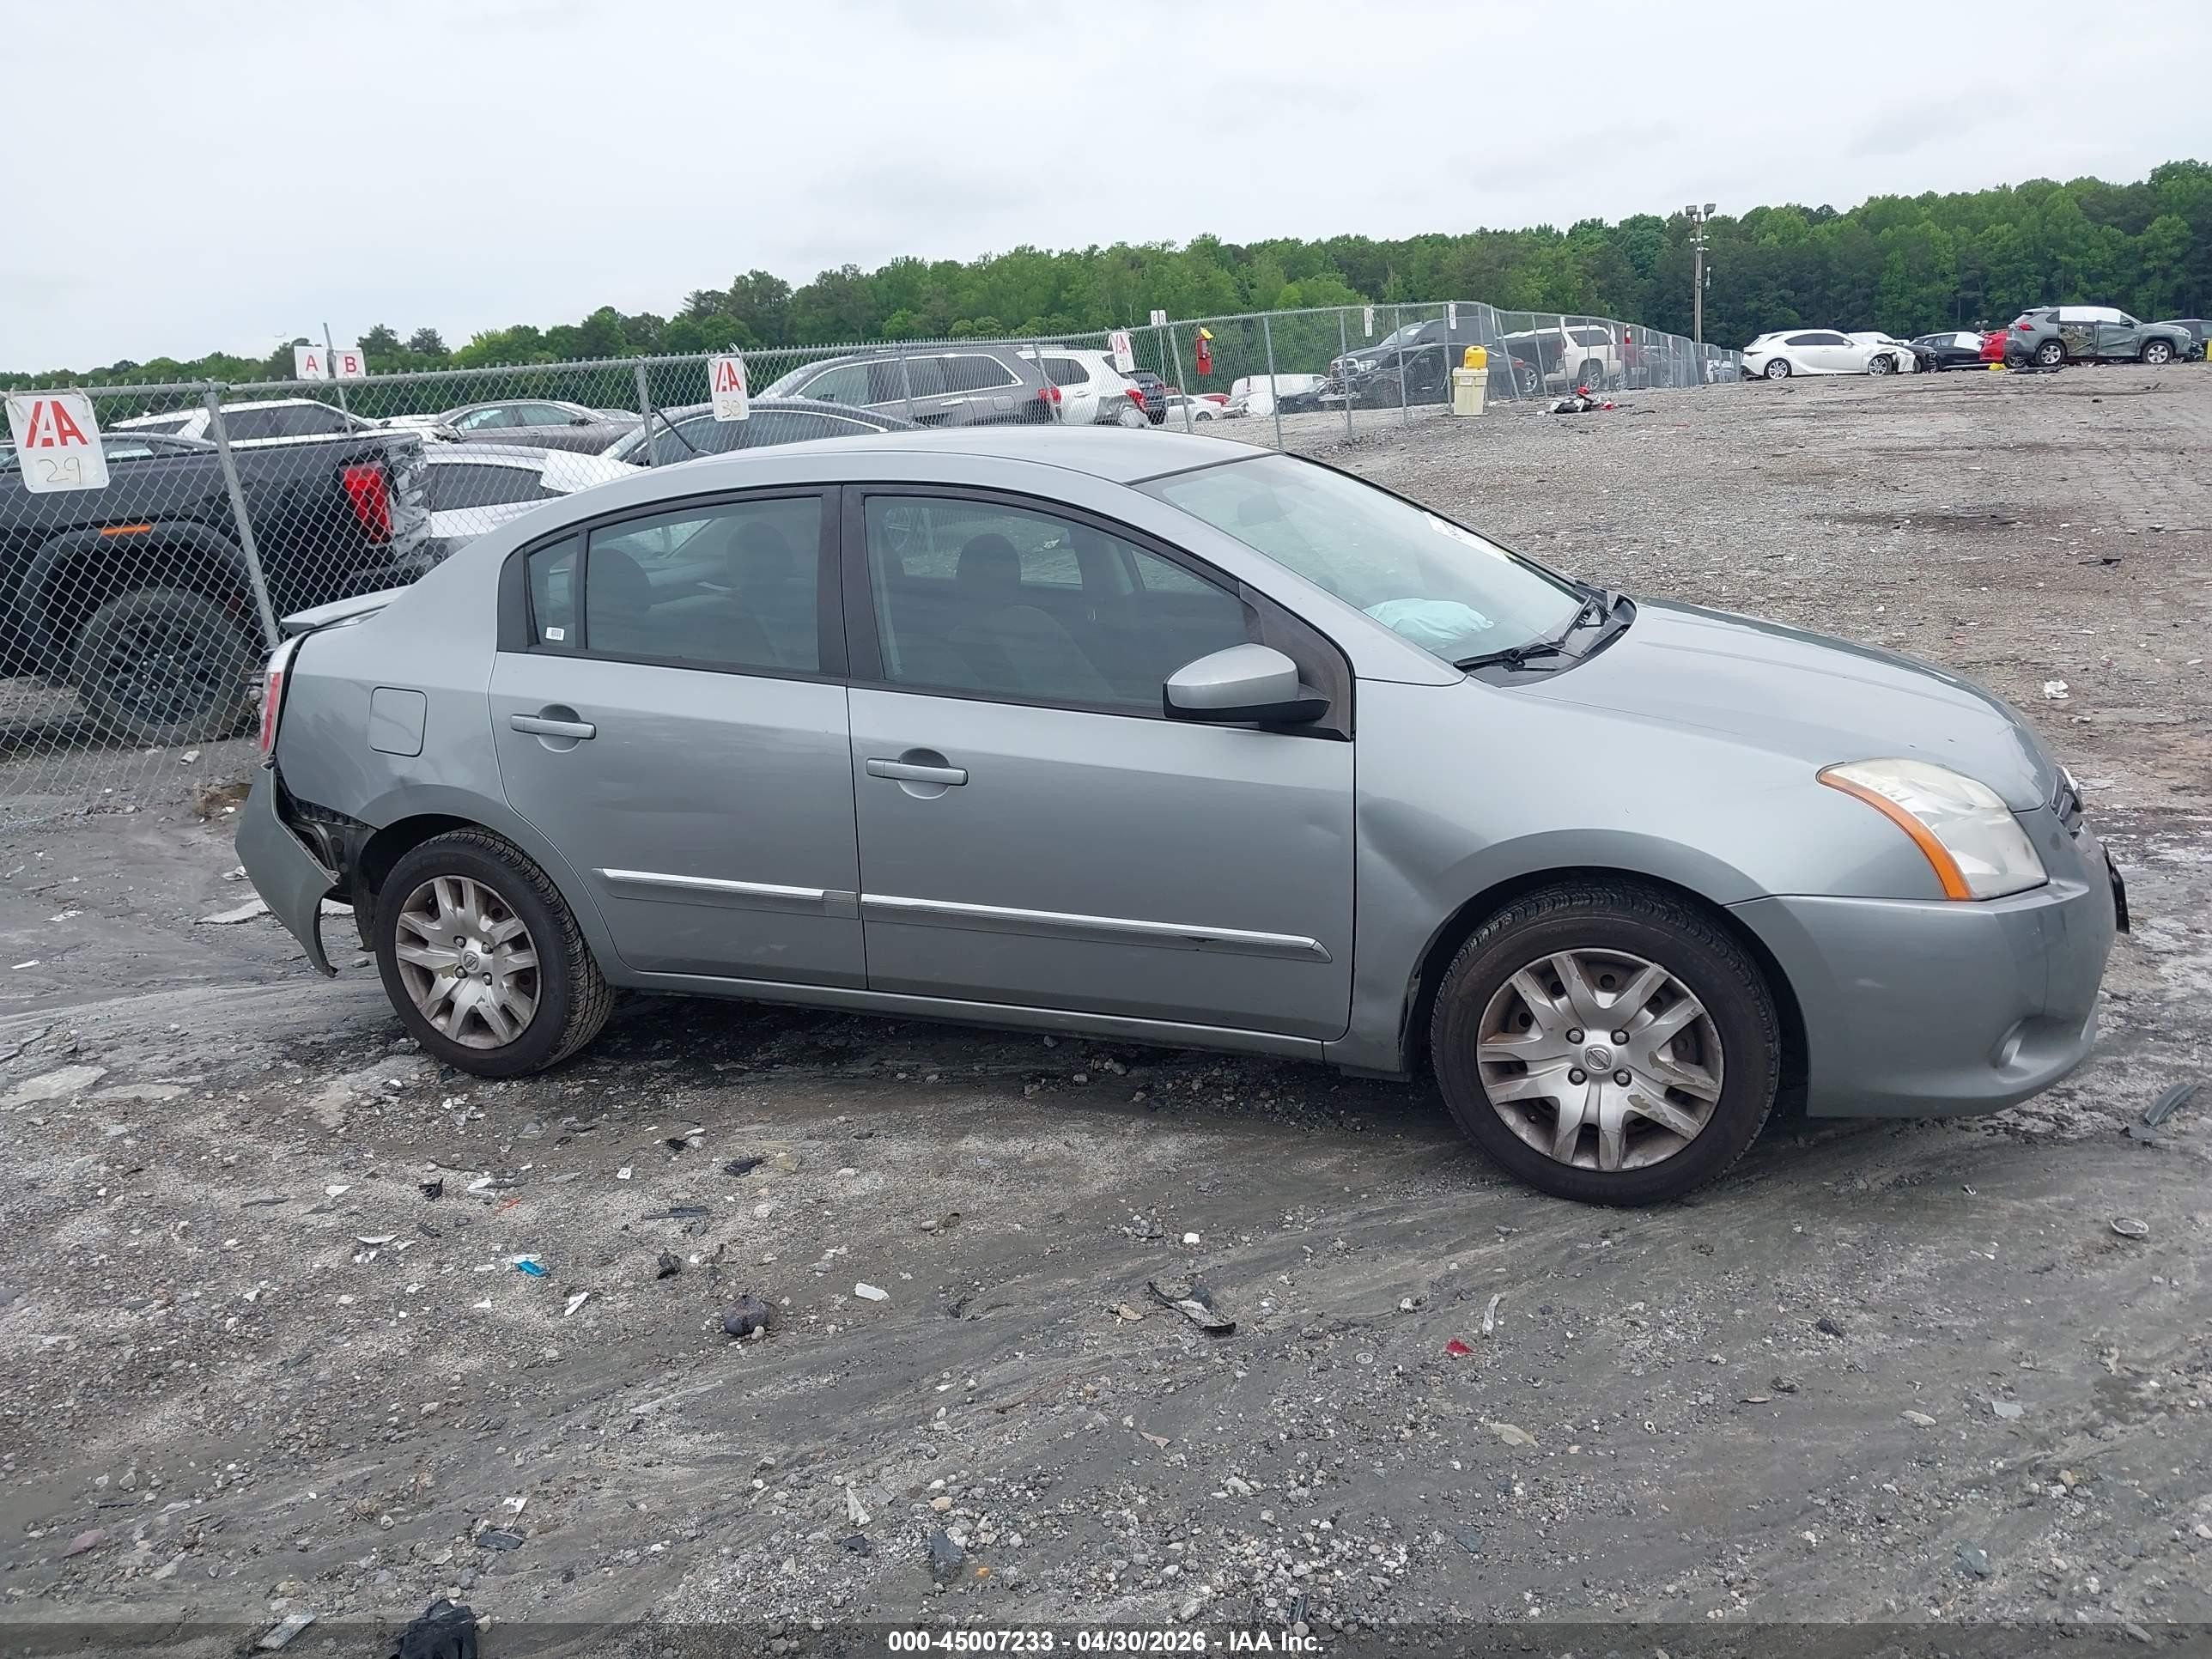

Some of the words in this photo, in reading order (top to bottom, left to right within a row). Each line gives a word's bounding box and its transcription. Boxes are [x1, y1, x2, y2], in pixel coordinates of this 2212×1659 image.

[306, 355, 319, 371] A
[345, 356, 356, 373] B
[39, 456, 82, 485] 29
